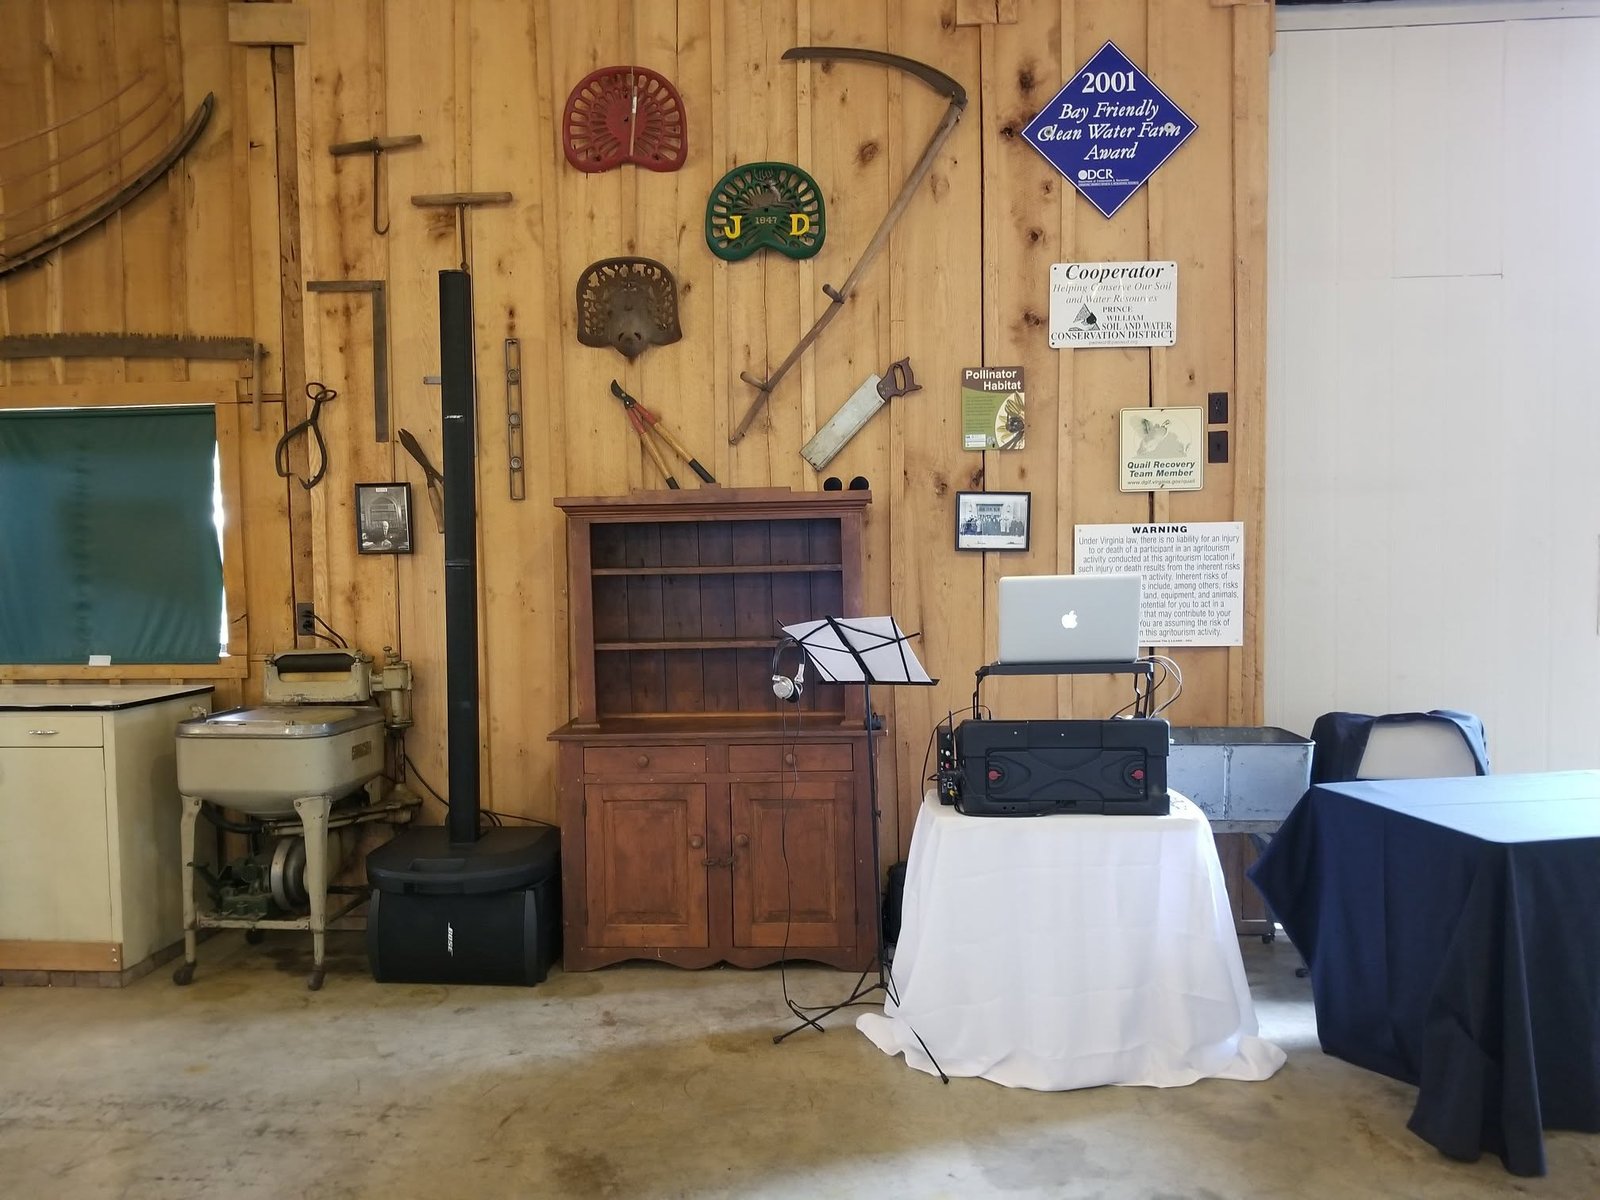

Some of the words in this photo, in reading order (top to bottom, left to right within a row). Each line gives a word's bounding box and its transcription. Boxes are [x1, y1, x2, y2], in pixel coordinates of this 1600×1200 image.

[1082, 71, 1136, 94] 2001
[1058, 103, 1089, 124] Bay
[1093, 99, 1159, 122] Friendly
[1037, 124, 1082, 142] Clean
[1088, 123, 1135, 140] Water
[1138, 121, 1181, 138] Farm
[1084, 142, 1139, 161] Award
[1087, 168, 1114, 180] DCR
[724, 215, 742, 239] J
[789, 213, 810, 236] D
[1065, 264, 1165, 283] Cooperator
[1053, 284, 1088, 293] Helping
[1090, 284, 1132, 292] Conserve
[1134, 282, 1153, 291] Our
[1154, 281, 1172, 290] Soil
[1065, 296, 1083, 304] and
[1085, 295, 1111, 304] Water
[1113, 294, 1158, 303] Resources
[1101, 323, 1121, 331] SOIL
[1142, 322, 1172, 330] WATER
[1051, 331, 1126, 340] CONSERVATION
[1128, 330, 1174, 339] DISTRICT
[965, 369, 1018, 380] Pollinator
[983, 380, 1022, 391] Habitat
[1153, 461, 1196, 469] Recovery
[1132, 526, 1188, 534] WARNING
[1078, 537, 1098, 545] Under
[1100, 537, 1124, 546] Virginia
[1126, 536, 1139, 545] law,
[1140, 535, 1157, 544] there
[1158, 535, 1165, 543] is
[1176, 534, 1199, 544] liability
[1200, 534, 1210, 542] for
[1221, 533, 1240, 544] injury
[1088, 547, 1096, 555] to
[1105, 546, 1124, 554] death
[1125, 545, 1133, 553] of
[1139, 545, 1174, 554] participant
[1192, 544, 1230, 554] agritourism
[1083, 554, 1106, 564] activity
[1108, 554, 1141, 563] conducted
[1143, 554, 1150, 562] at
[1151, 553, 1163, 562] this
[1164, 553, 1202, 563] agritourism
[1203, 552, 1229, 561] location
[1230, 552, 1236, 560] if
[1078, 565, 1094, 573] such
[1095, 564, 1113, 575] injury
[1123, 564, 1142, 572] death
[1143, 563, 1167, 571] results
[1167, 563, 1183, 571] from
[1184, 562, 1196, 571] the
[1197, 562, 1223, 571] inherent
[1224, 561, 1241, 570] risks
[1148, 573, 1174, 582] activity.
[1175, 572, 1202, 580] Inherent
[1203, 571, 1220, 580] risks
[1220, 571, 1229, 580] of
[1147, 581, 1173, 591] include,
[1173, 582, 1197, 591] among
[1198, 581, 1222, 590] others,
[1222, 580, 1240, 589] risks
[1143, 591, 1159, 599] land,
[1160, 591, 1197, 600] equipment,
[1197, 591, 1211, 599] and
[1211, 590, 1240, 599] animals,
[1167, 600, 1178, 608] for
[1178, 601, 1192, 609] you
[1192, 600, 1200, 608] to
[1200, 600, 1211, 608] act
[1143, 610, 1157, 618] that
[1158, 610, 1173, 619] may
[1173, 610, 1207, 618] contribute
[1207, 609, 1215, 617] to
[1215, 610, 1231, 619] your
[1164, 619, 1196, 628] assuming
[1197, 619, 1208, 627] the
[1209, 618, 1221, 627] risk
[1222, 618, 1230, 626] of
[1145, 629, 1158, 637] this
[1158, 629, 1196, 638] agritourism
[1197, 628, 1223, 638] activity.
